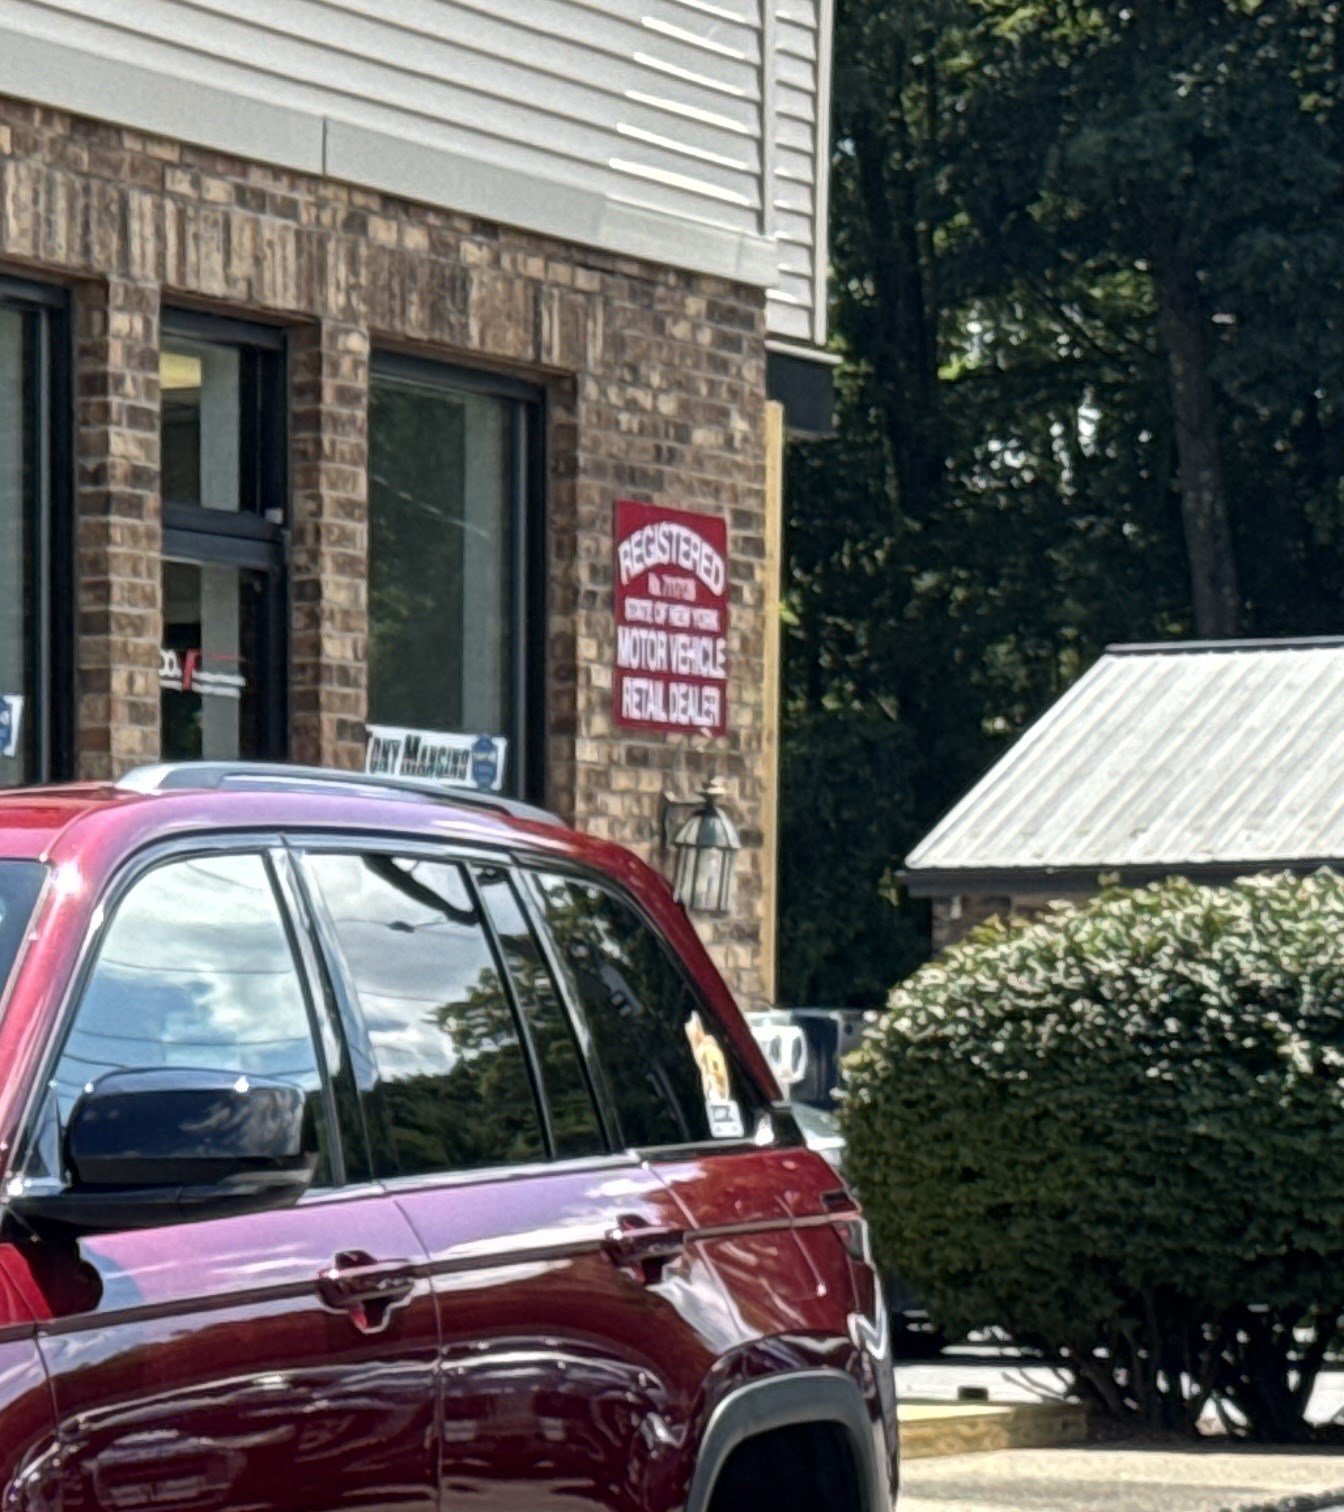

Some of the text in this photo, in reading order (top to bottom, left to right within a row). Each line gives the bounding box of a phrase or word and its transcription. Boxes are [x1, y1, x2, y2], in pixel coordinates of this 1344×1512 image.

[618, 521, 725, 596] REGISTERED
[617, 625, 727, 679] MOTOR VEHICLE
[622, 676, 721, 727] RETAIL DEALER
